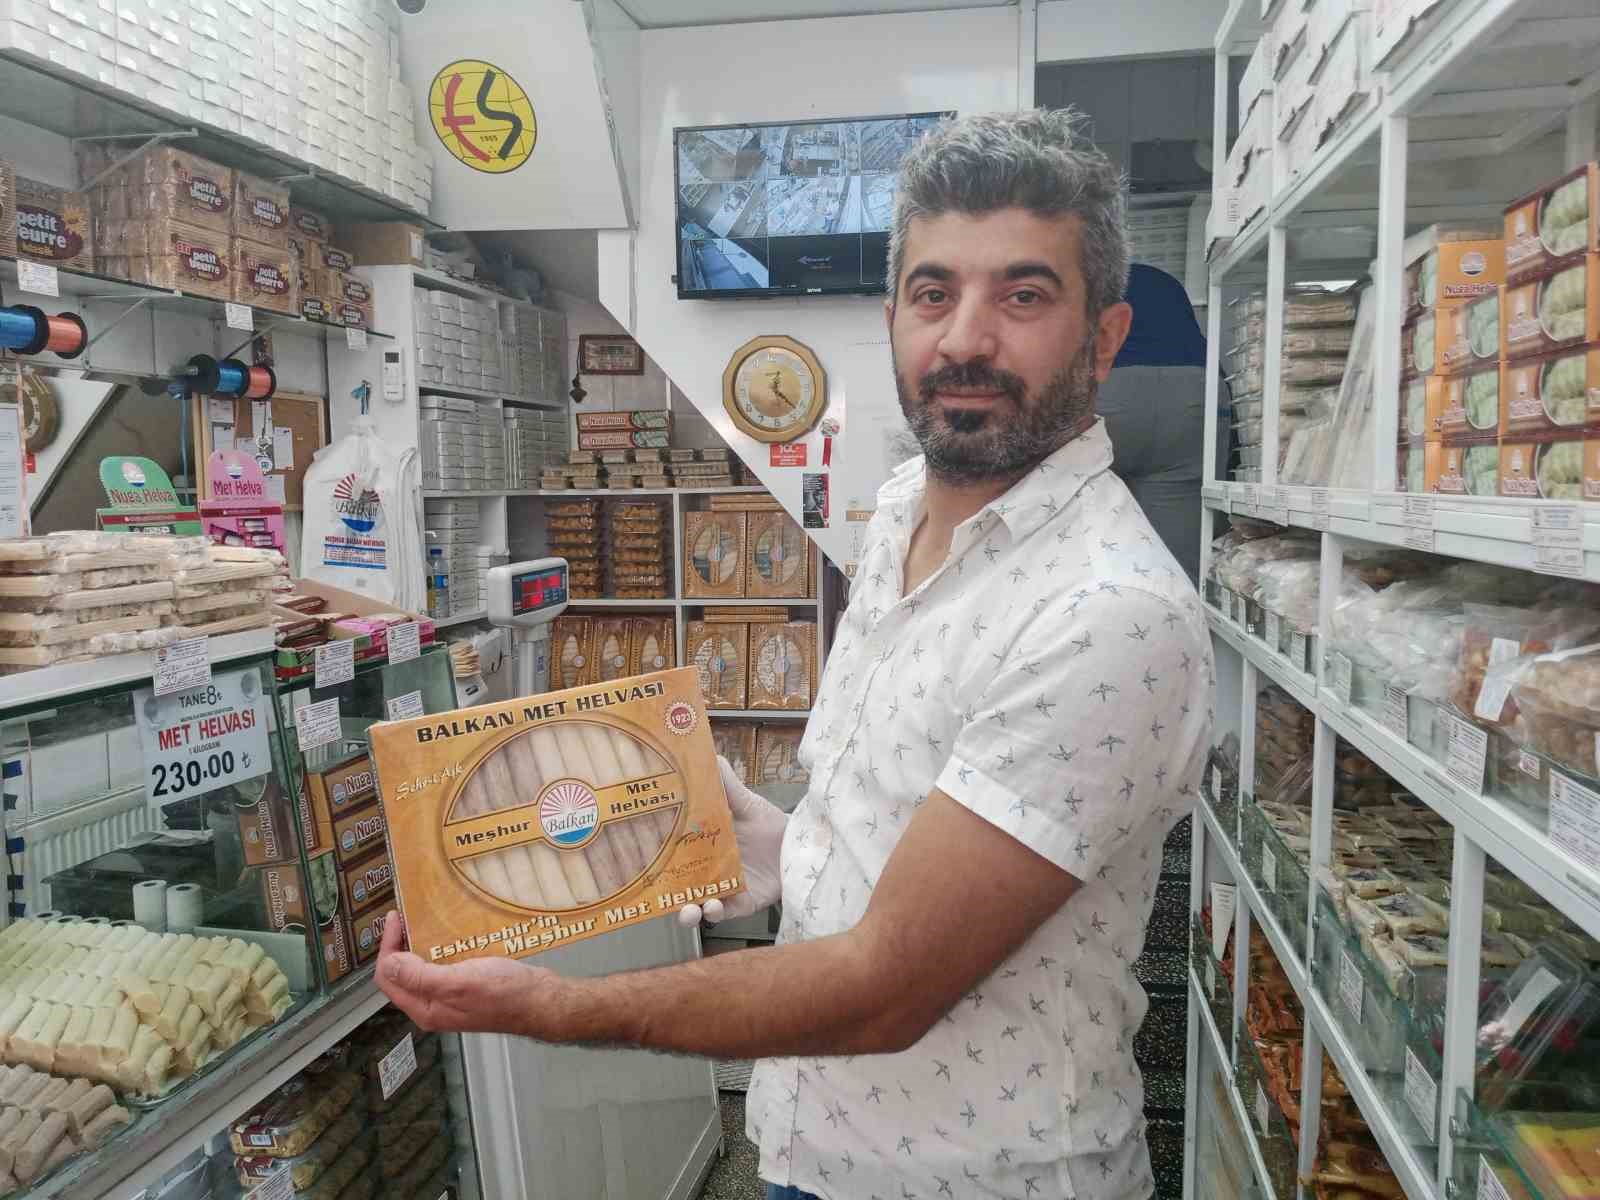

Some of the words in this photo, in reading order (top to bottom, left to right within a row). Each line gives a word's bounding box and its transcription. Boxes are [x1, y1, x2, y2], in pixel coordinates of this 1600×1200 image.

[16, 210, 57, 232] petit
[213, 480, 233, 496] Met
[235, 479, 262, 496] Helva
[178, 692, 206, 709] TANE
[416, 711, 515, 743] BALKAN
[522, 699, 569, 722] MET
[575, 680, 666, 712] HELVASI
[158, 723, 191, 751] MET
[625, 779, 659, 796] Met
[610, 790, 677, 815] Helvası
[455, 820, 531, 848] Meşhur
[546, 810, 596, 834] Balkan
[503, 918, 599, 955] Meşhur
[603, 900, 651, 927] Met
[656, 876, 740, 909] Helvası
